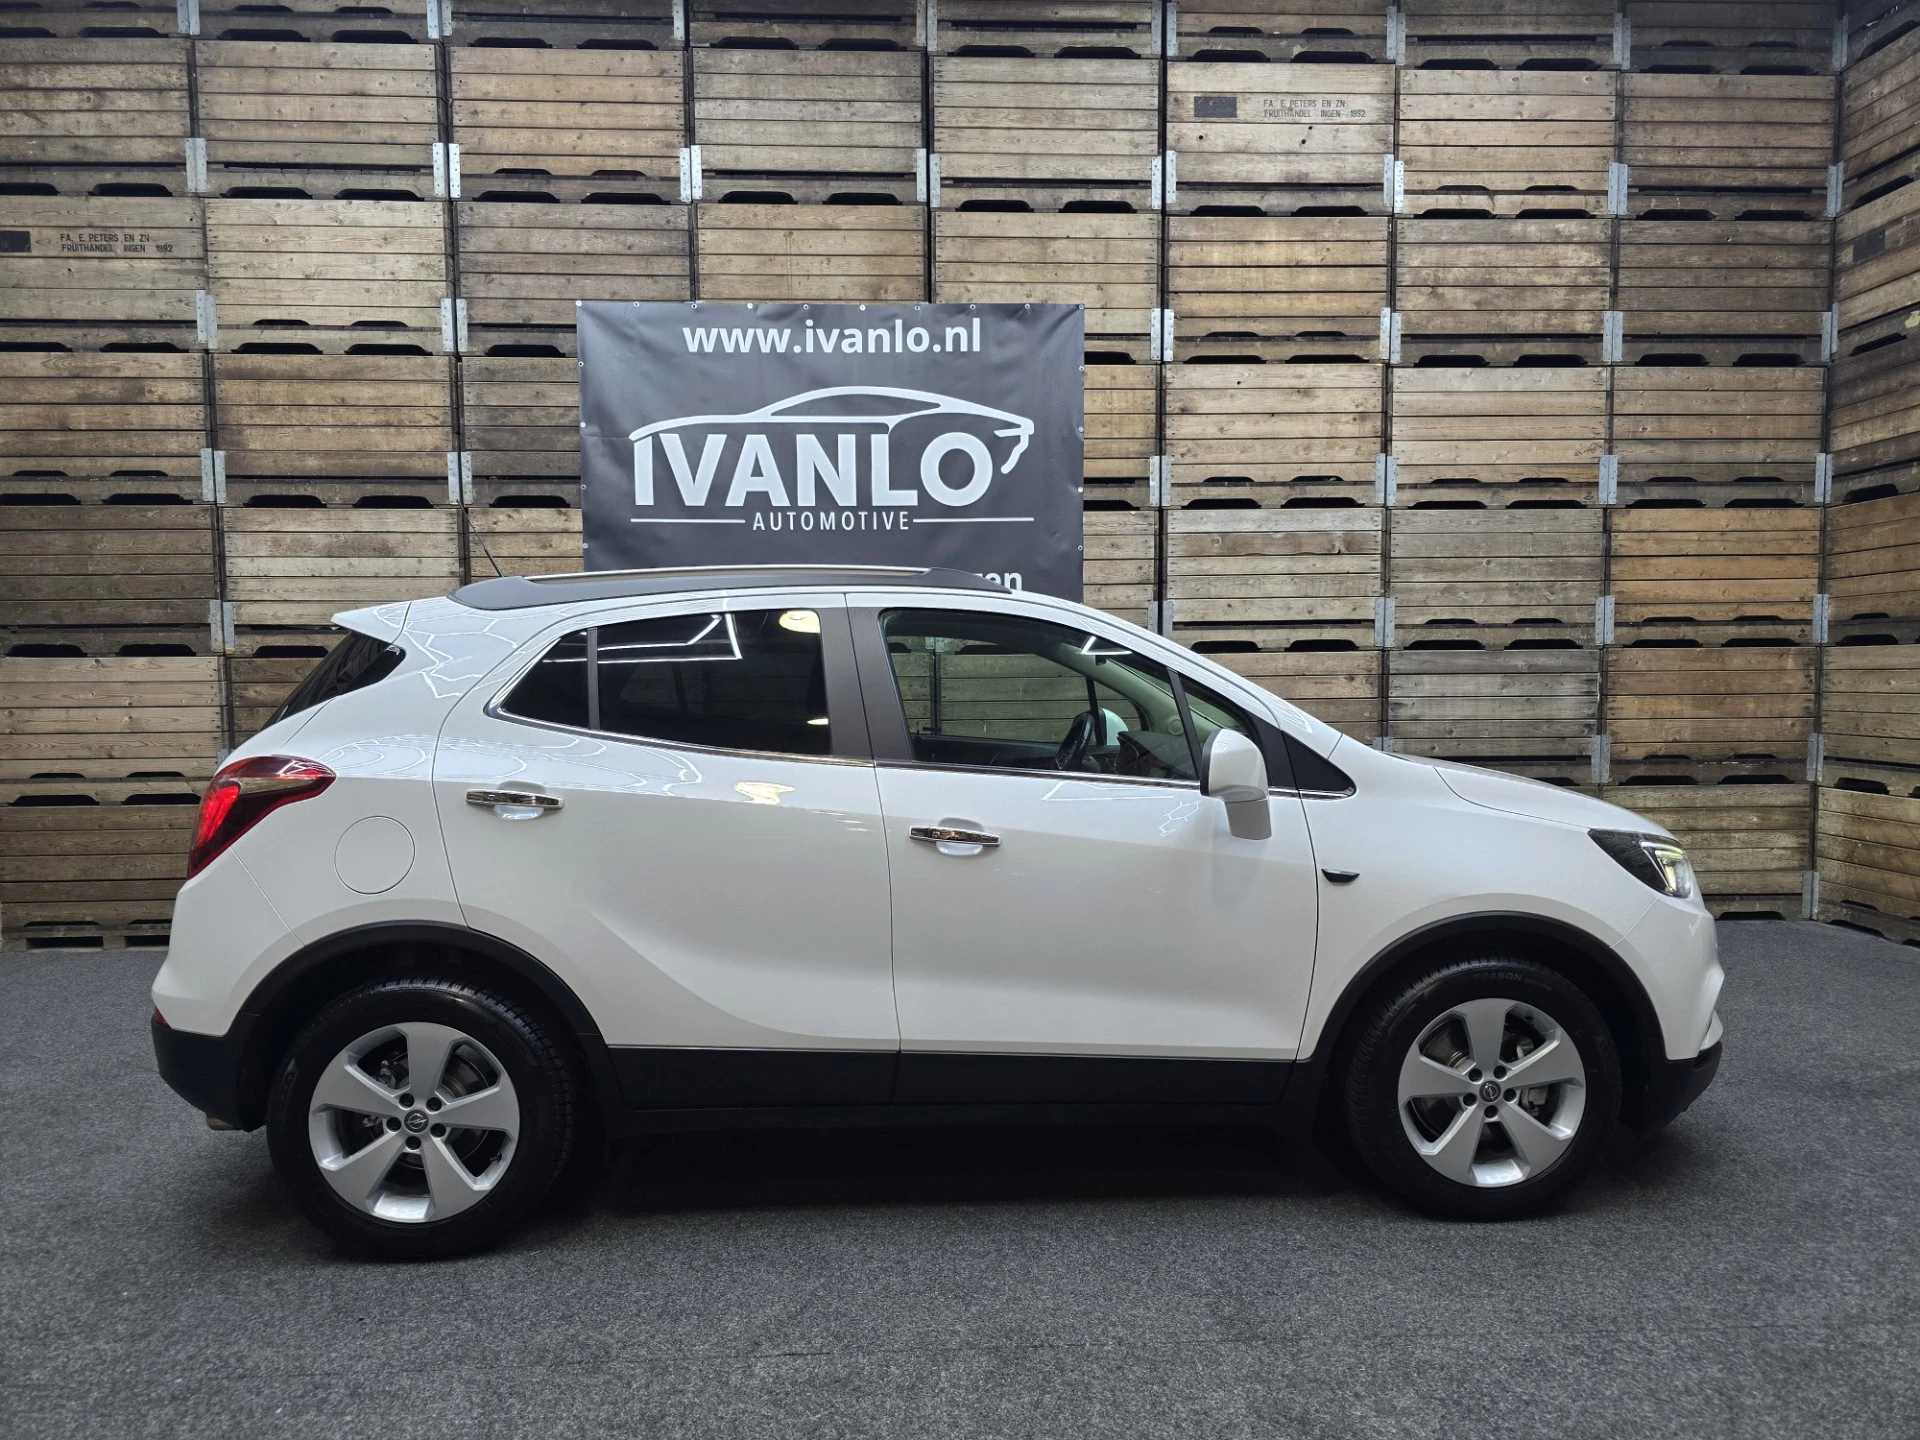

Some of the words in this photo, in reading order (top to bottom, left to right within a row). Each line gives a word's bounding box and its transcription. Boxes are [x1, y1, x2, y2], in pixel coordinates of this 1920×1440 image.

[1289, 99, 1317, 108] PETERS
[1321, 99, 1332, 108] EN
[1335, 99, 1346, 108] ZN
[1263, 109, 1312, 118] FRUITHANDEL
[1320, 109, 1341, 118] INGEN
[60, 233, 74, 243] FA.
[88, 233, 119, 243] PETERS
[123, 234, 135, 243] EN
[139, 234, 150, 243] ZN
[61, 243, 114, 253] FRUITHANDEL
[123, 244, 146, 253] INGEN
[682, 317, 981, 354] www.ivanlo.nl
[633, 431, 994, 507] IVANLO
[752, 511, 910, 531] AUTOMOTIVE
